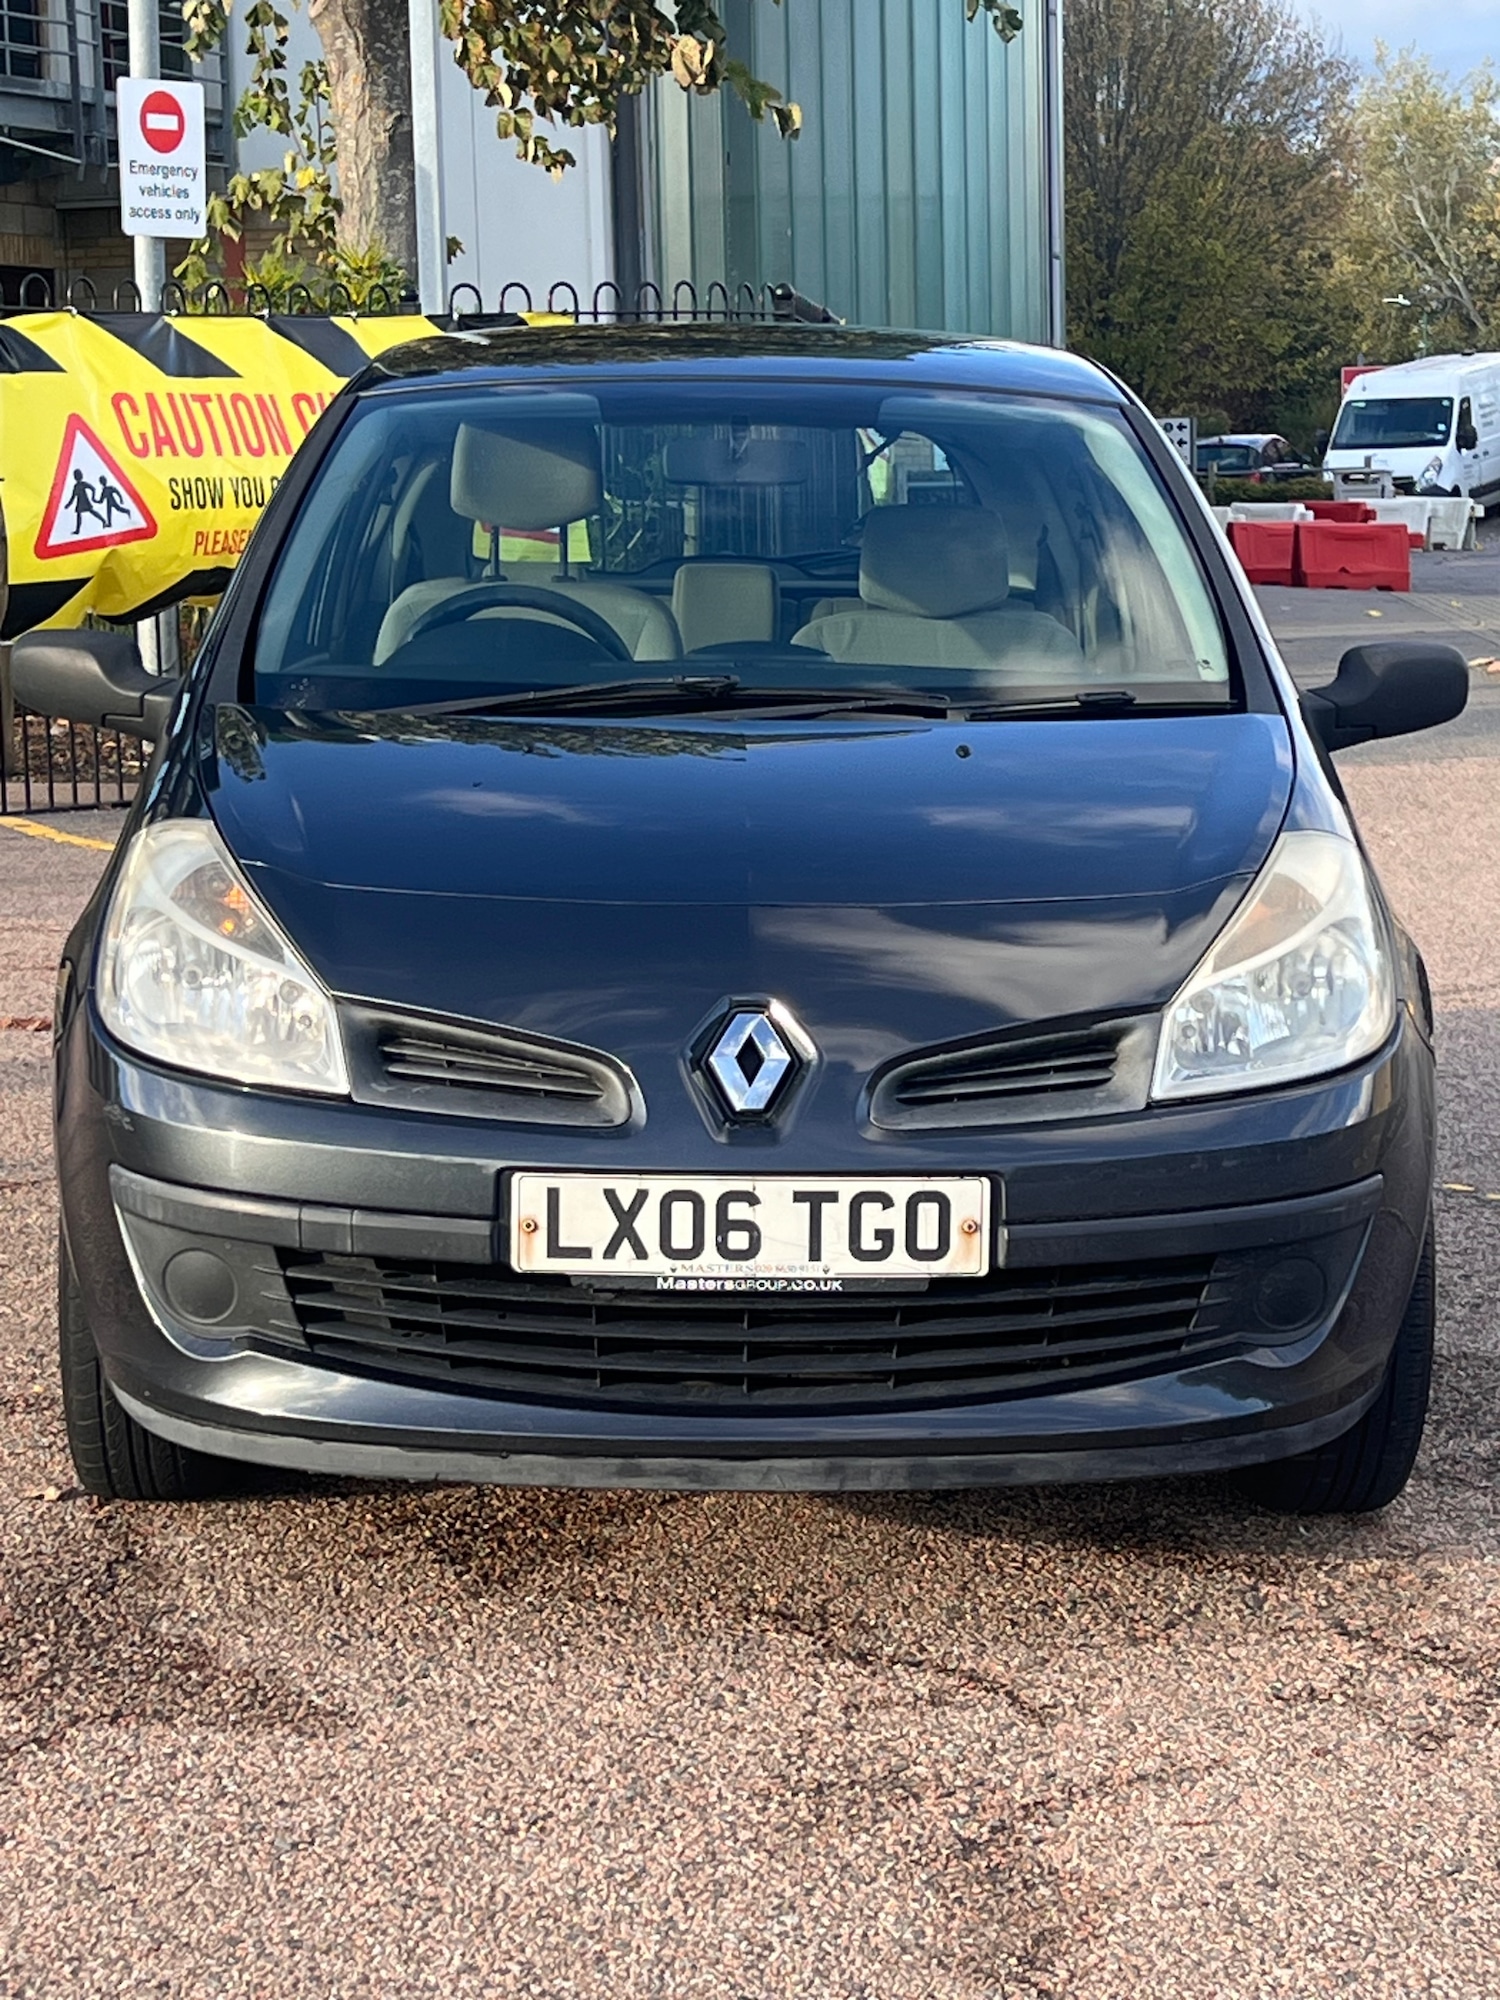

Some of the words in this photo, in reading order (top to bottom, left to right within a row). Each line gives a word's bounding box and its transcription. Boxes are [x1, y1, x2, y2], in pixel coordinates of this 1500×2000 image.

[129, 160, 198, 182] Emergency
[139, 183, 189, 199] vehicles
[129, 206, 171, 220] access
[175, 207, 200, 225] only
[111, 392, 294, 459] CAUTION
[168, 476, 224, 511] SHOW
[229, 475, 265, 509] YOU
[193, 529, 248, 557] PLEASE
[546, 1187, 762, 1262] LX06
[793, 1189, 951, 1263] TGO
[680, 1263, 753, 1274] MASTERS
